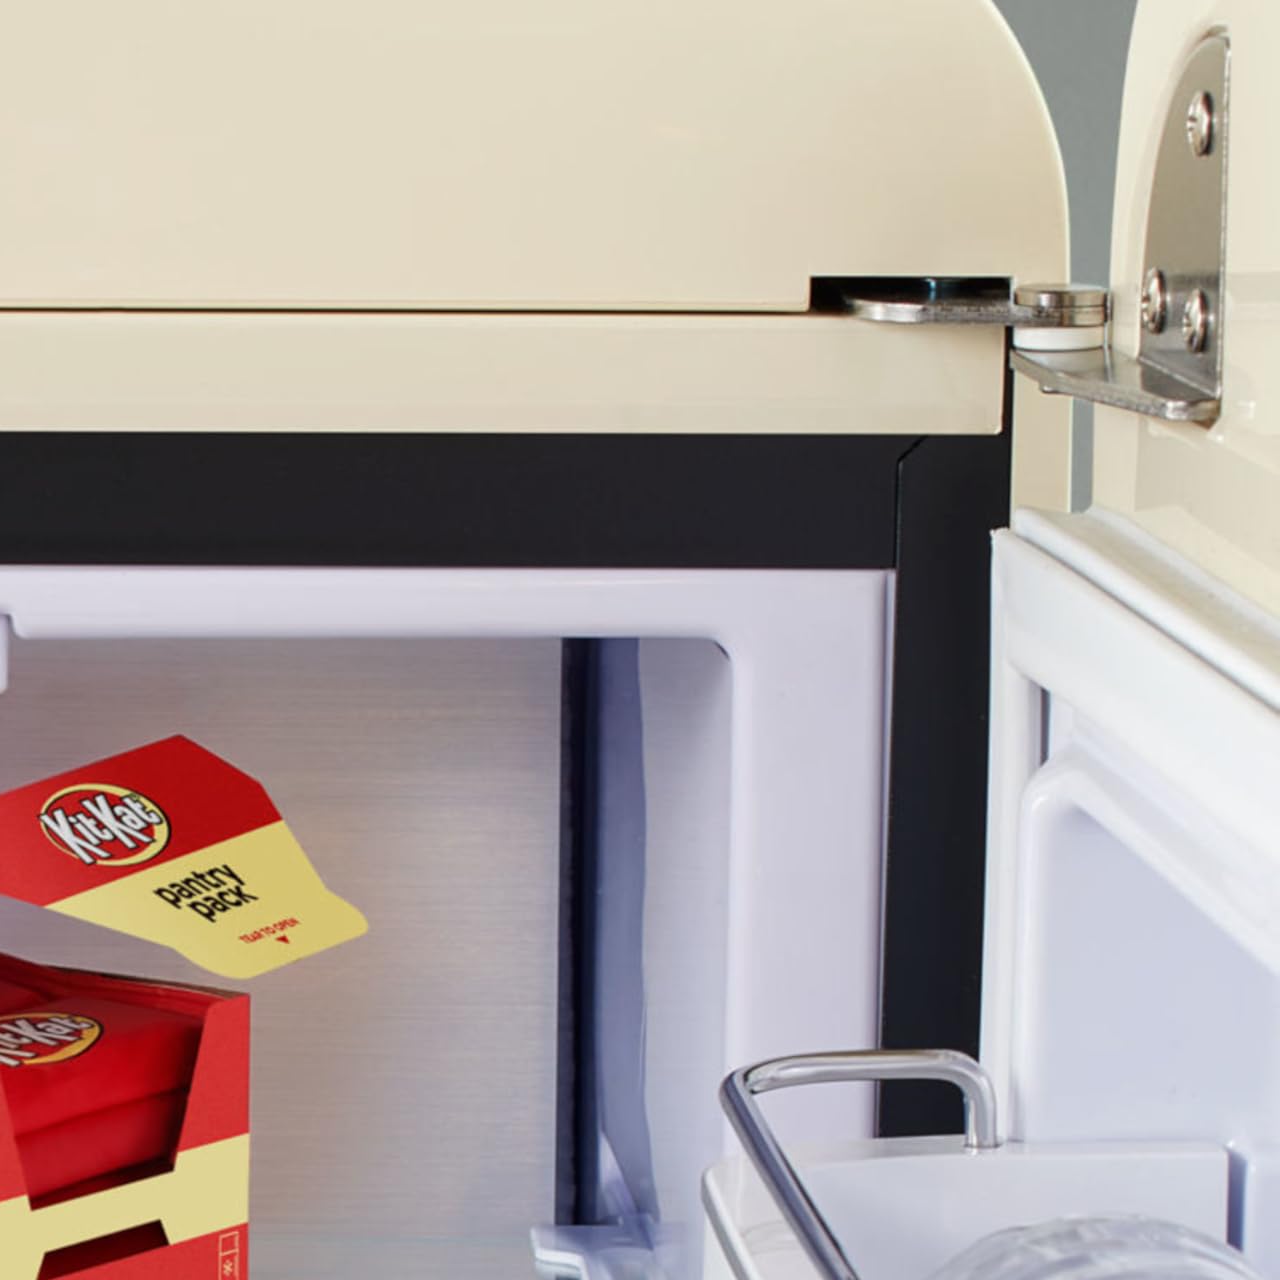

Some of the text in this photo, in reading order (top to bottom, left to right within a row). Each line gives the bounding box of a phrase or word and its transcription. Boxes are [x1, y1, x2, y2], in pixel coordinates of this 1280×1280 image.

[38, 794, 163, 866] KitKat
[153, 864, 246, 909] pantry
[186, 884, 260, 923] pack
